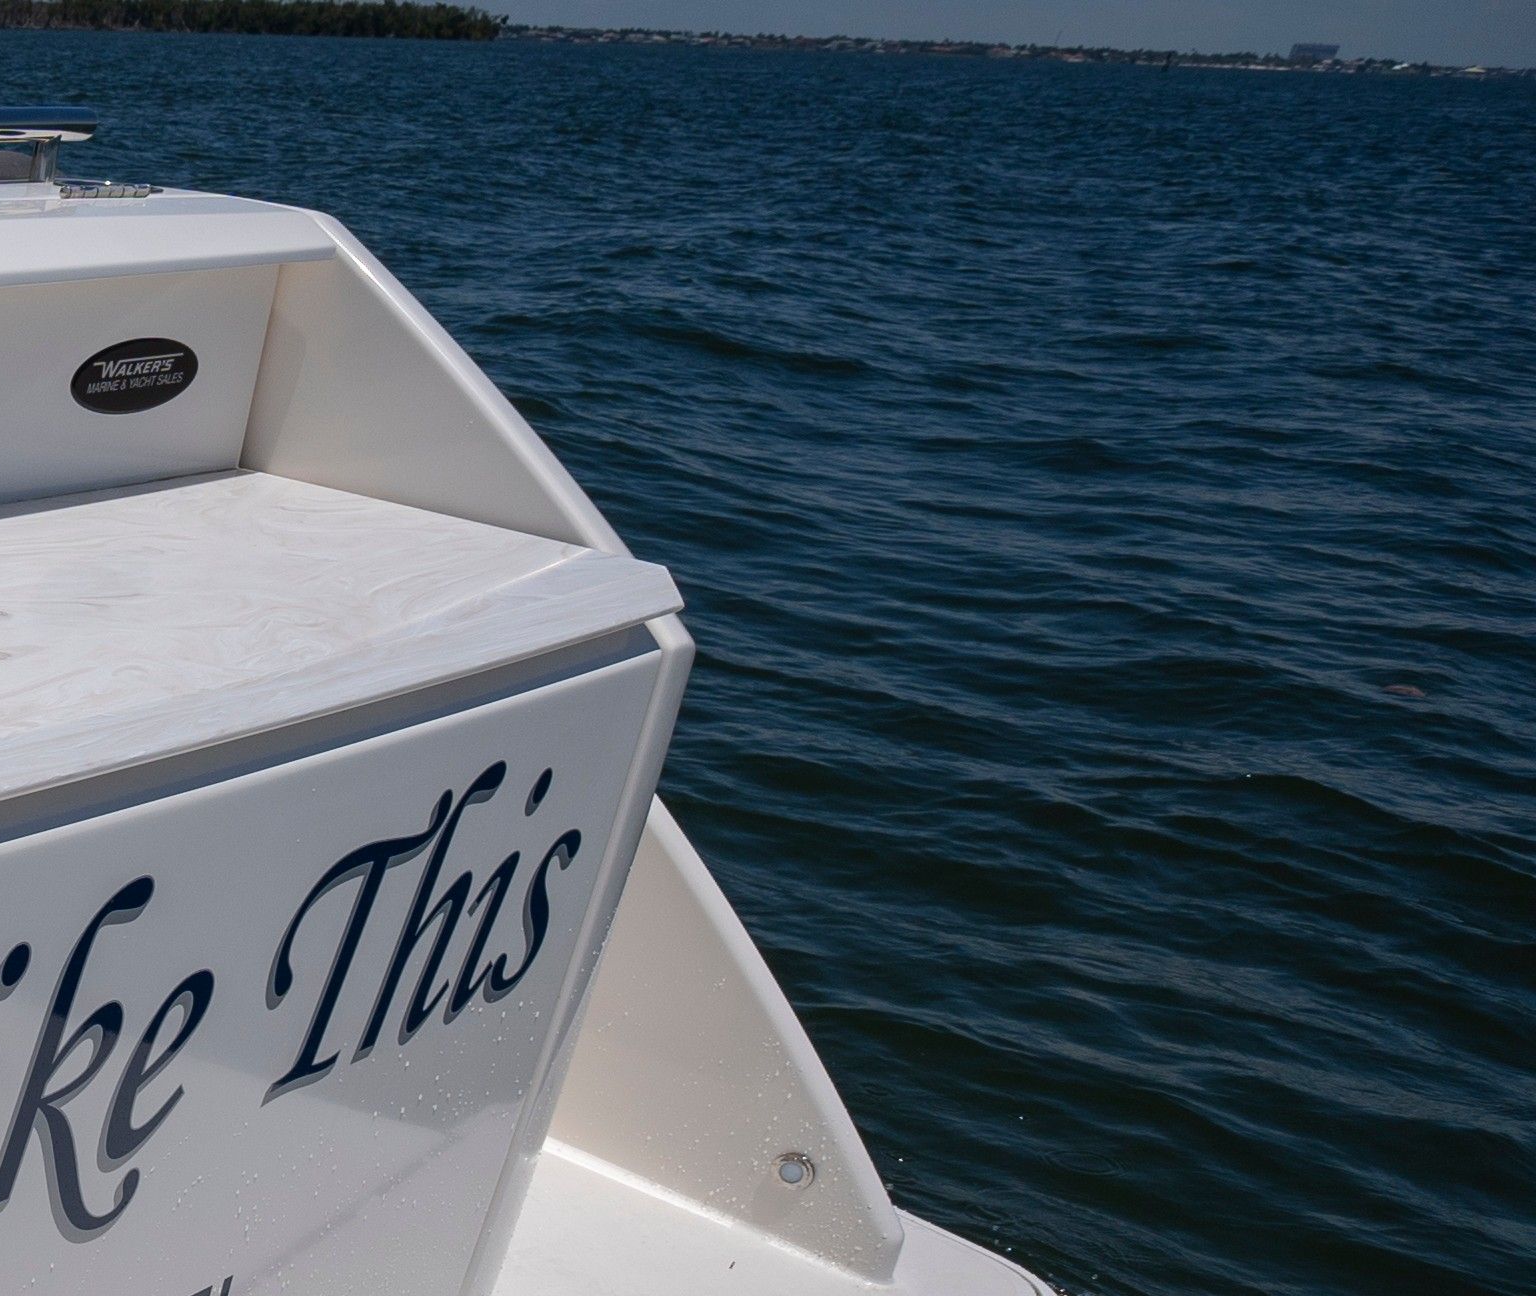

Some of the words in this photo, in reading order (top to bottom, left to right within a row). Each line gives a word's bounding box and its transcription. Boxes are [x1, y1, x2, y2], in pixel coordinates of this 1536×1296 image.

[93, 357, 175, 379] WALKER'S
[86, 379, 121, 395] MARINE
[120, 378, 127, 391] &
[129, 374, 157, 389] YACHT
[156, 371, 185, 387] SALES
[261, 759, 583, 1106] This
